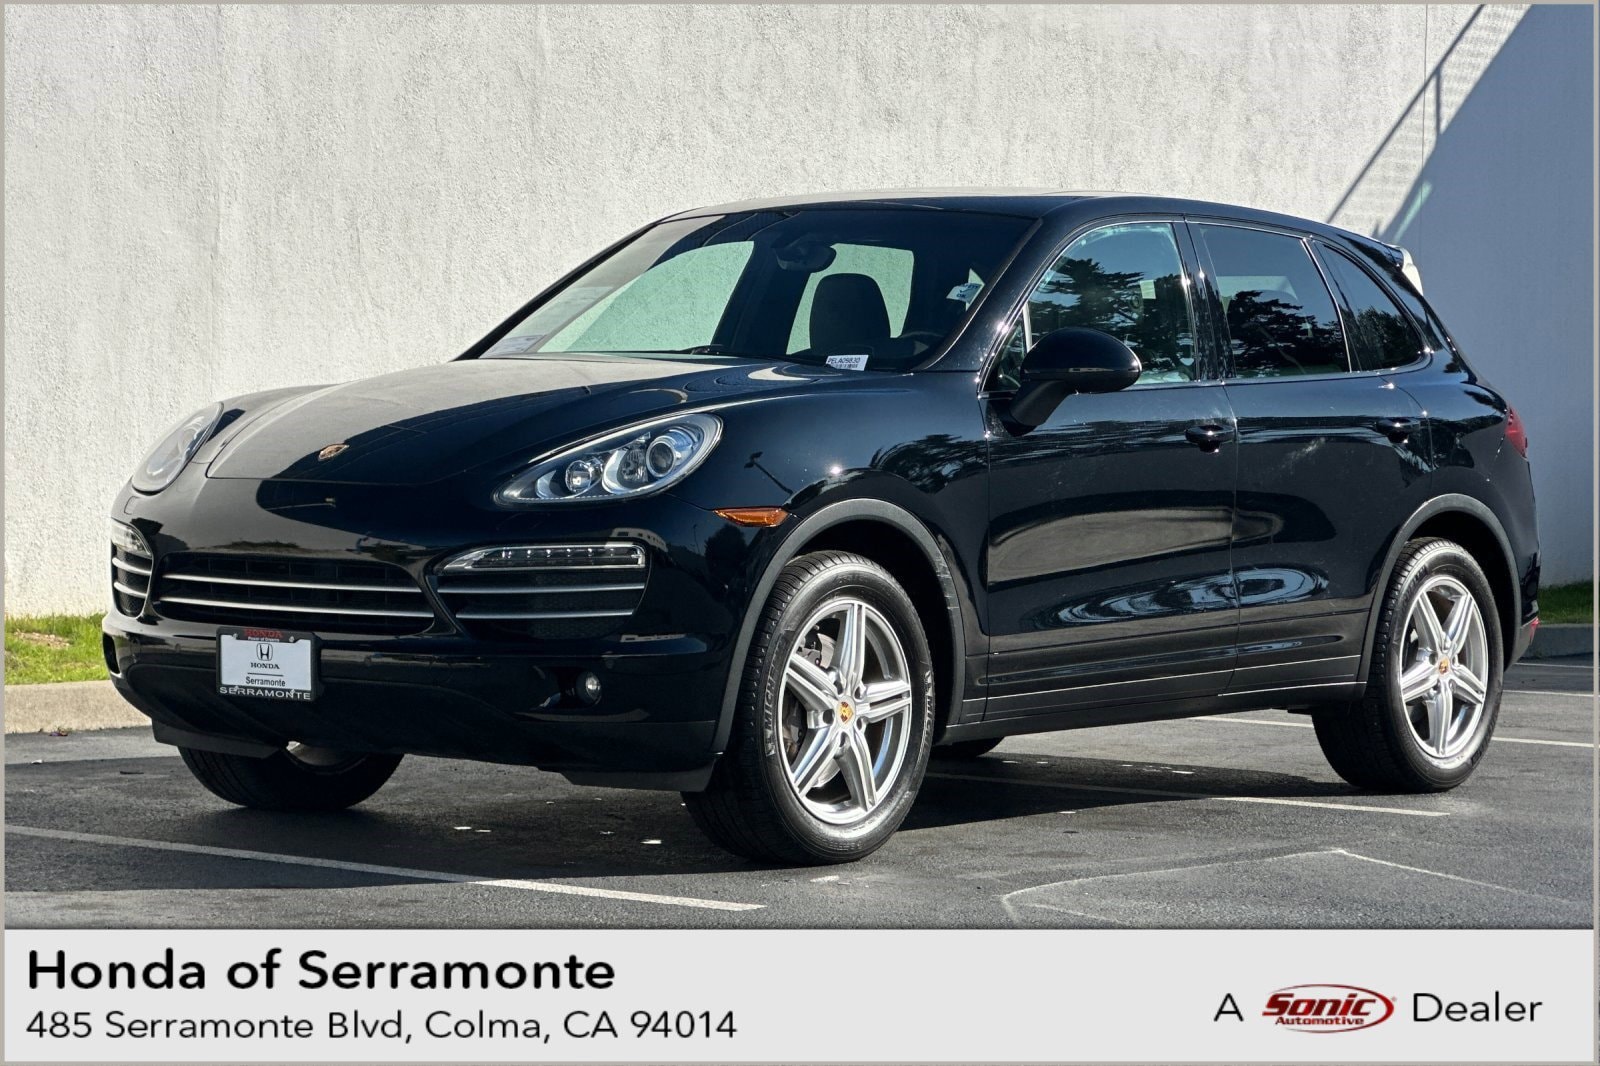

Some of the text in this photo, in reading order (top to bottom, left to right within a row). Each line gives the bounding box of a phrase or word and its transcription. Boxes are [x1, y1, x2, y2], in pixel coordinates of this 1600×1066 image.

[244, 628, 284, 638] HONDA
[250, 662, 281, 670] HONDA
[245, 676, 286, 687] Serramonte
[219, 686, 312, 700] SERRAMONTE
